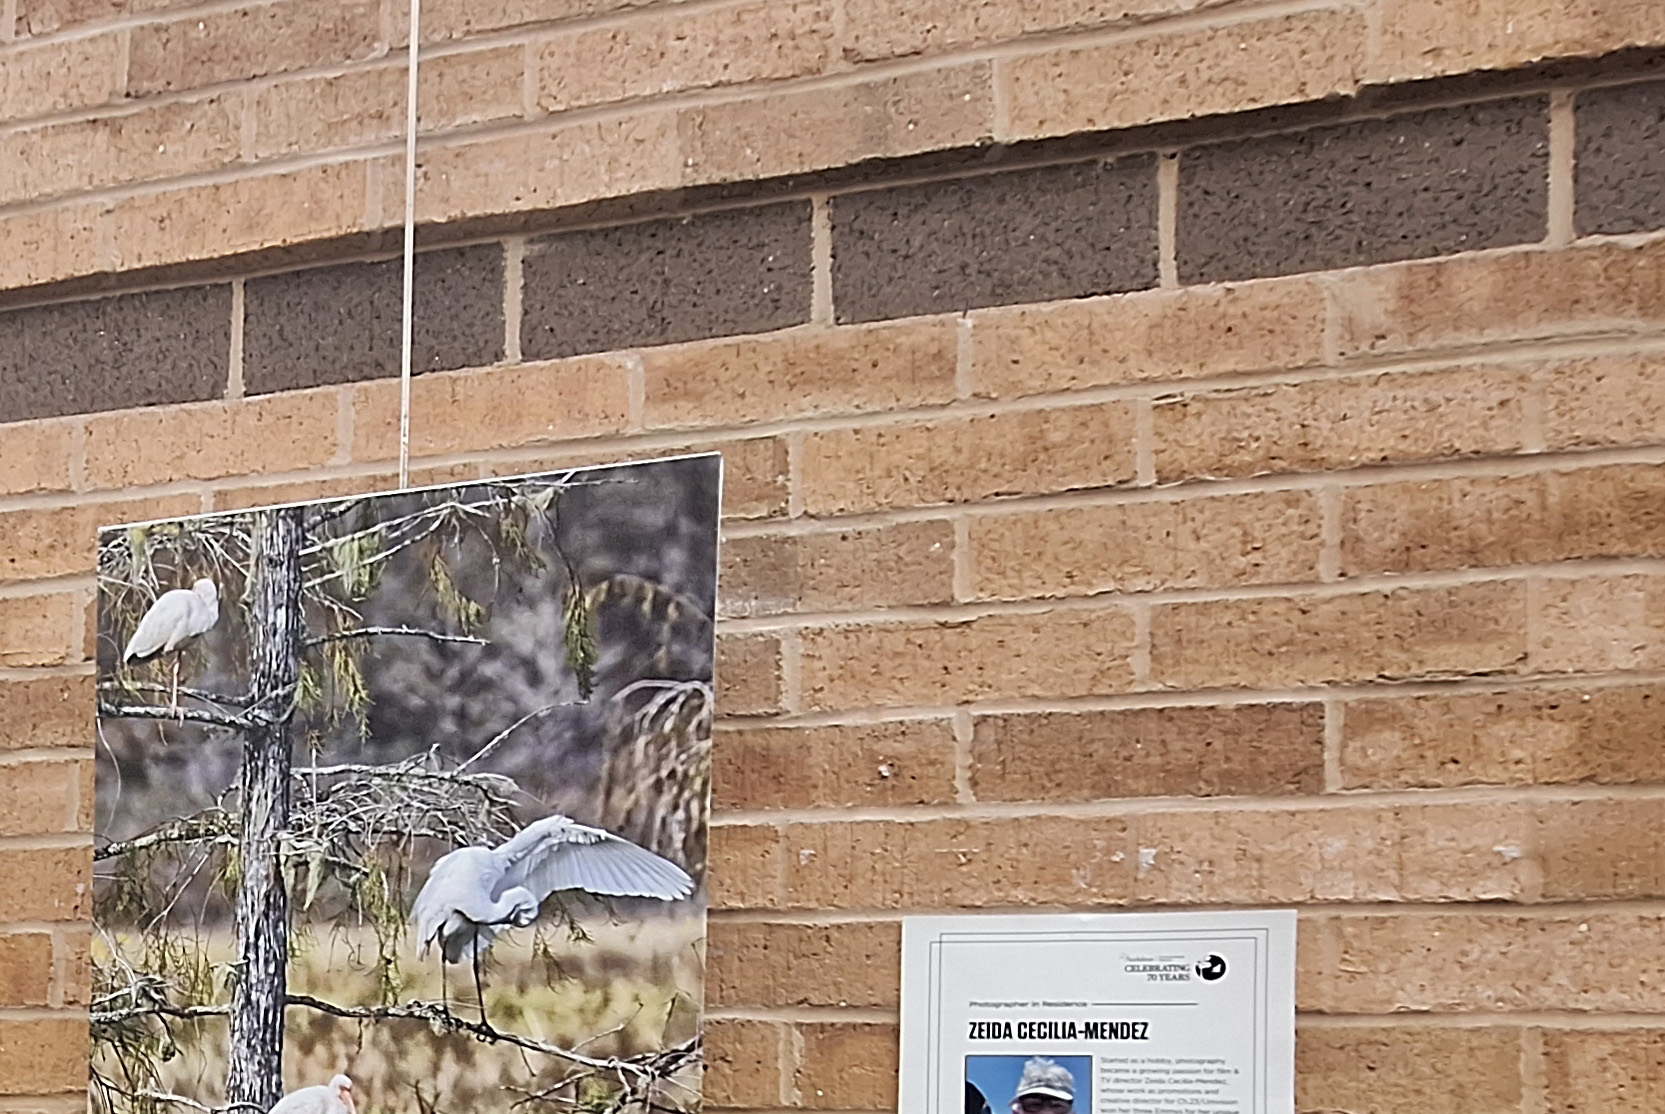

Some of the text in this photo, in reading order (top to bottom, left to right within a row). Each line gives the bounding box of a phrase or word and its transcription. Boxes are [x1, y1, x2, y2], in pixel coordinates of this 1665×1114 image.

[1124, 964, 1190, 973] CELEBRATING
[969, 1022, 1149, 1040] ZEIDA CECILIA-MENDEZ
